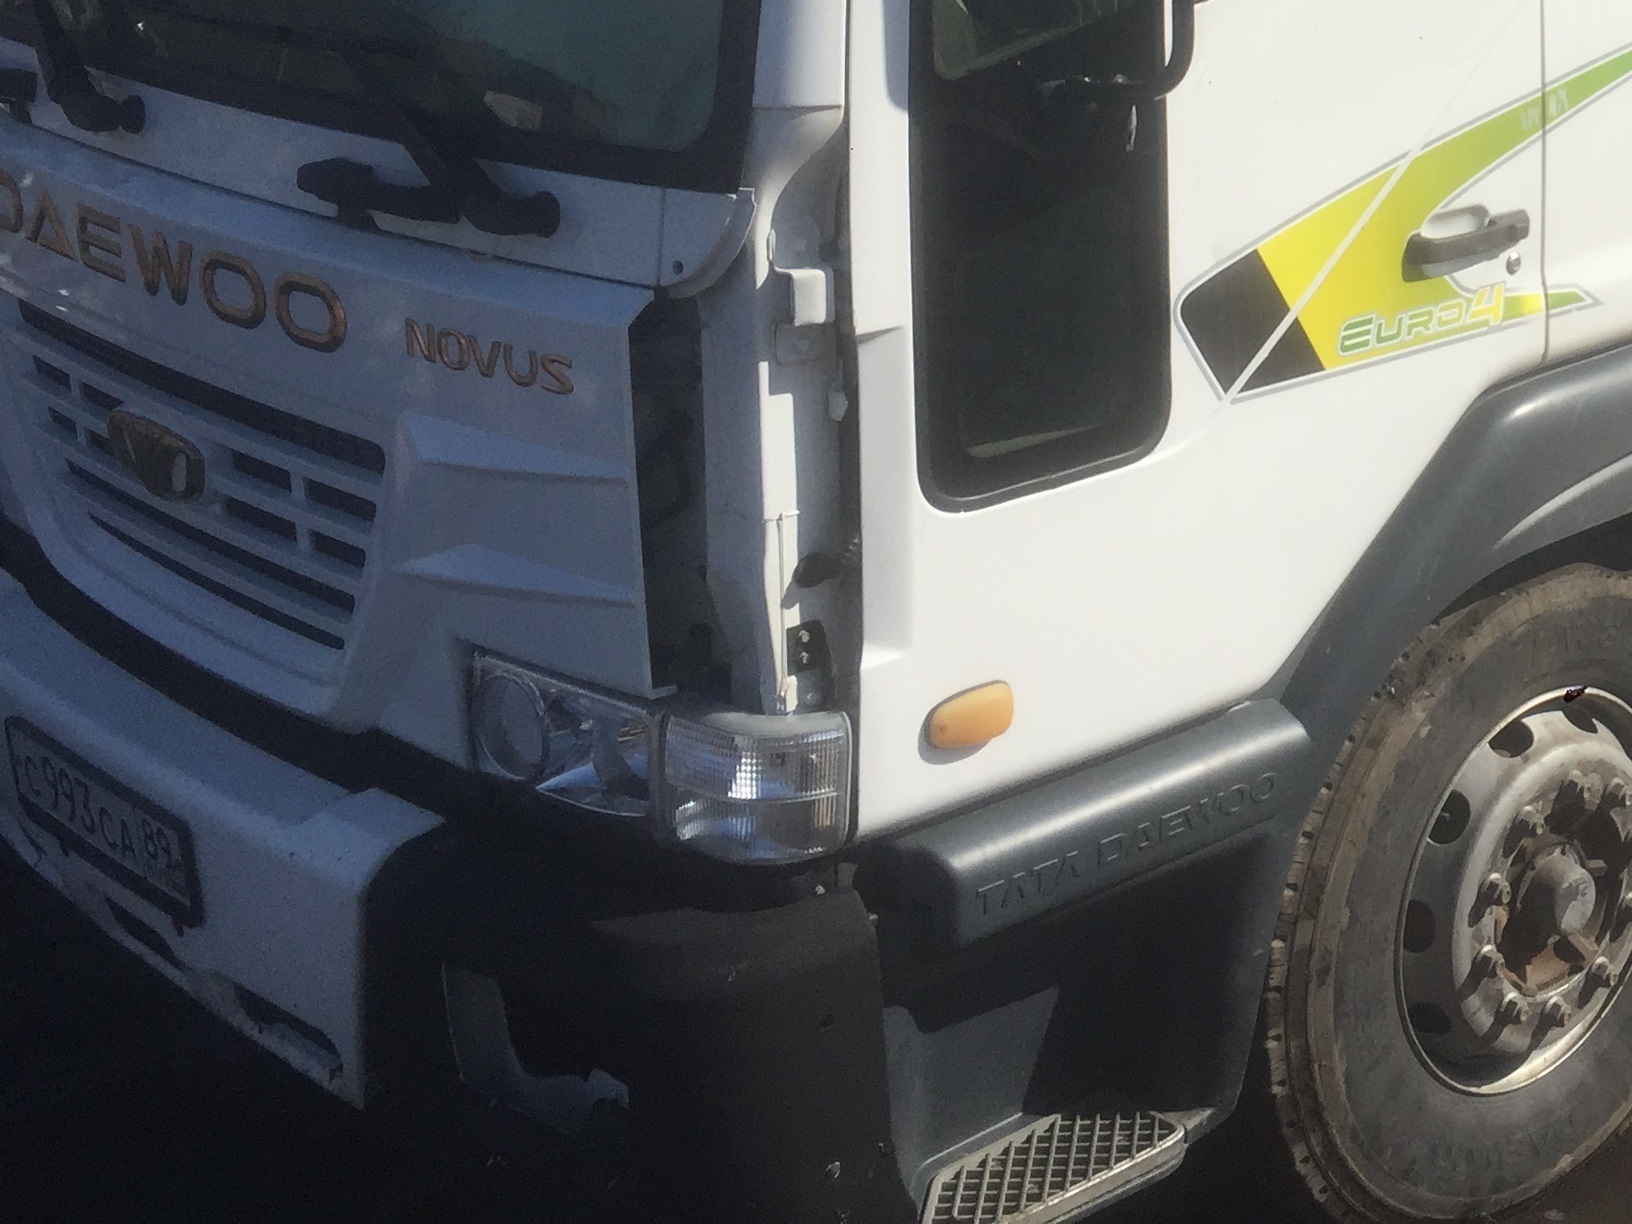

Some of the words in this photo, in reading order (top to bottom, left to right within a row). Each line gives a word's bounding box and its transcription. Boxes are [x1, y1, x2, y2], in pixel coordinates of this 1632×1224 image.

[405, 317, 574, 395] NOVUS
[974, 848, 1079, 915] TATA
[1097, 771, 1277, 868] DAEWOO
